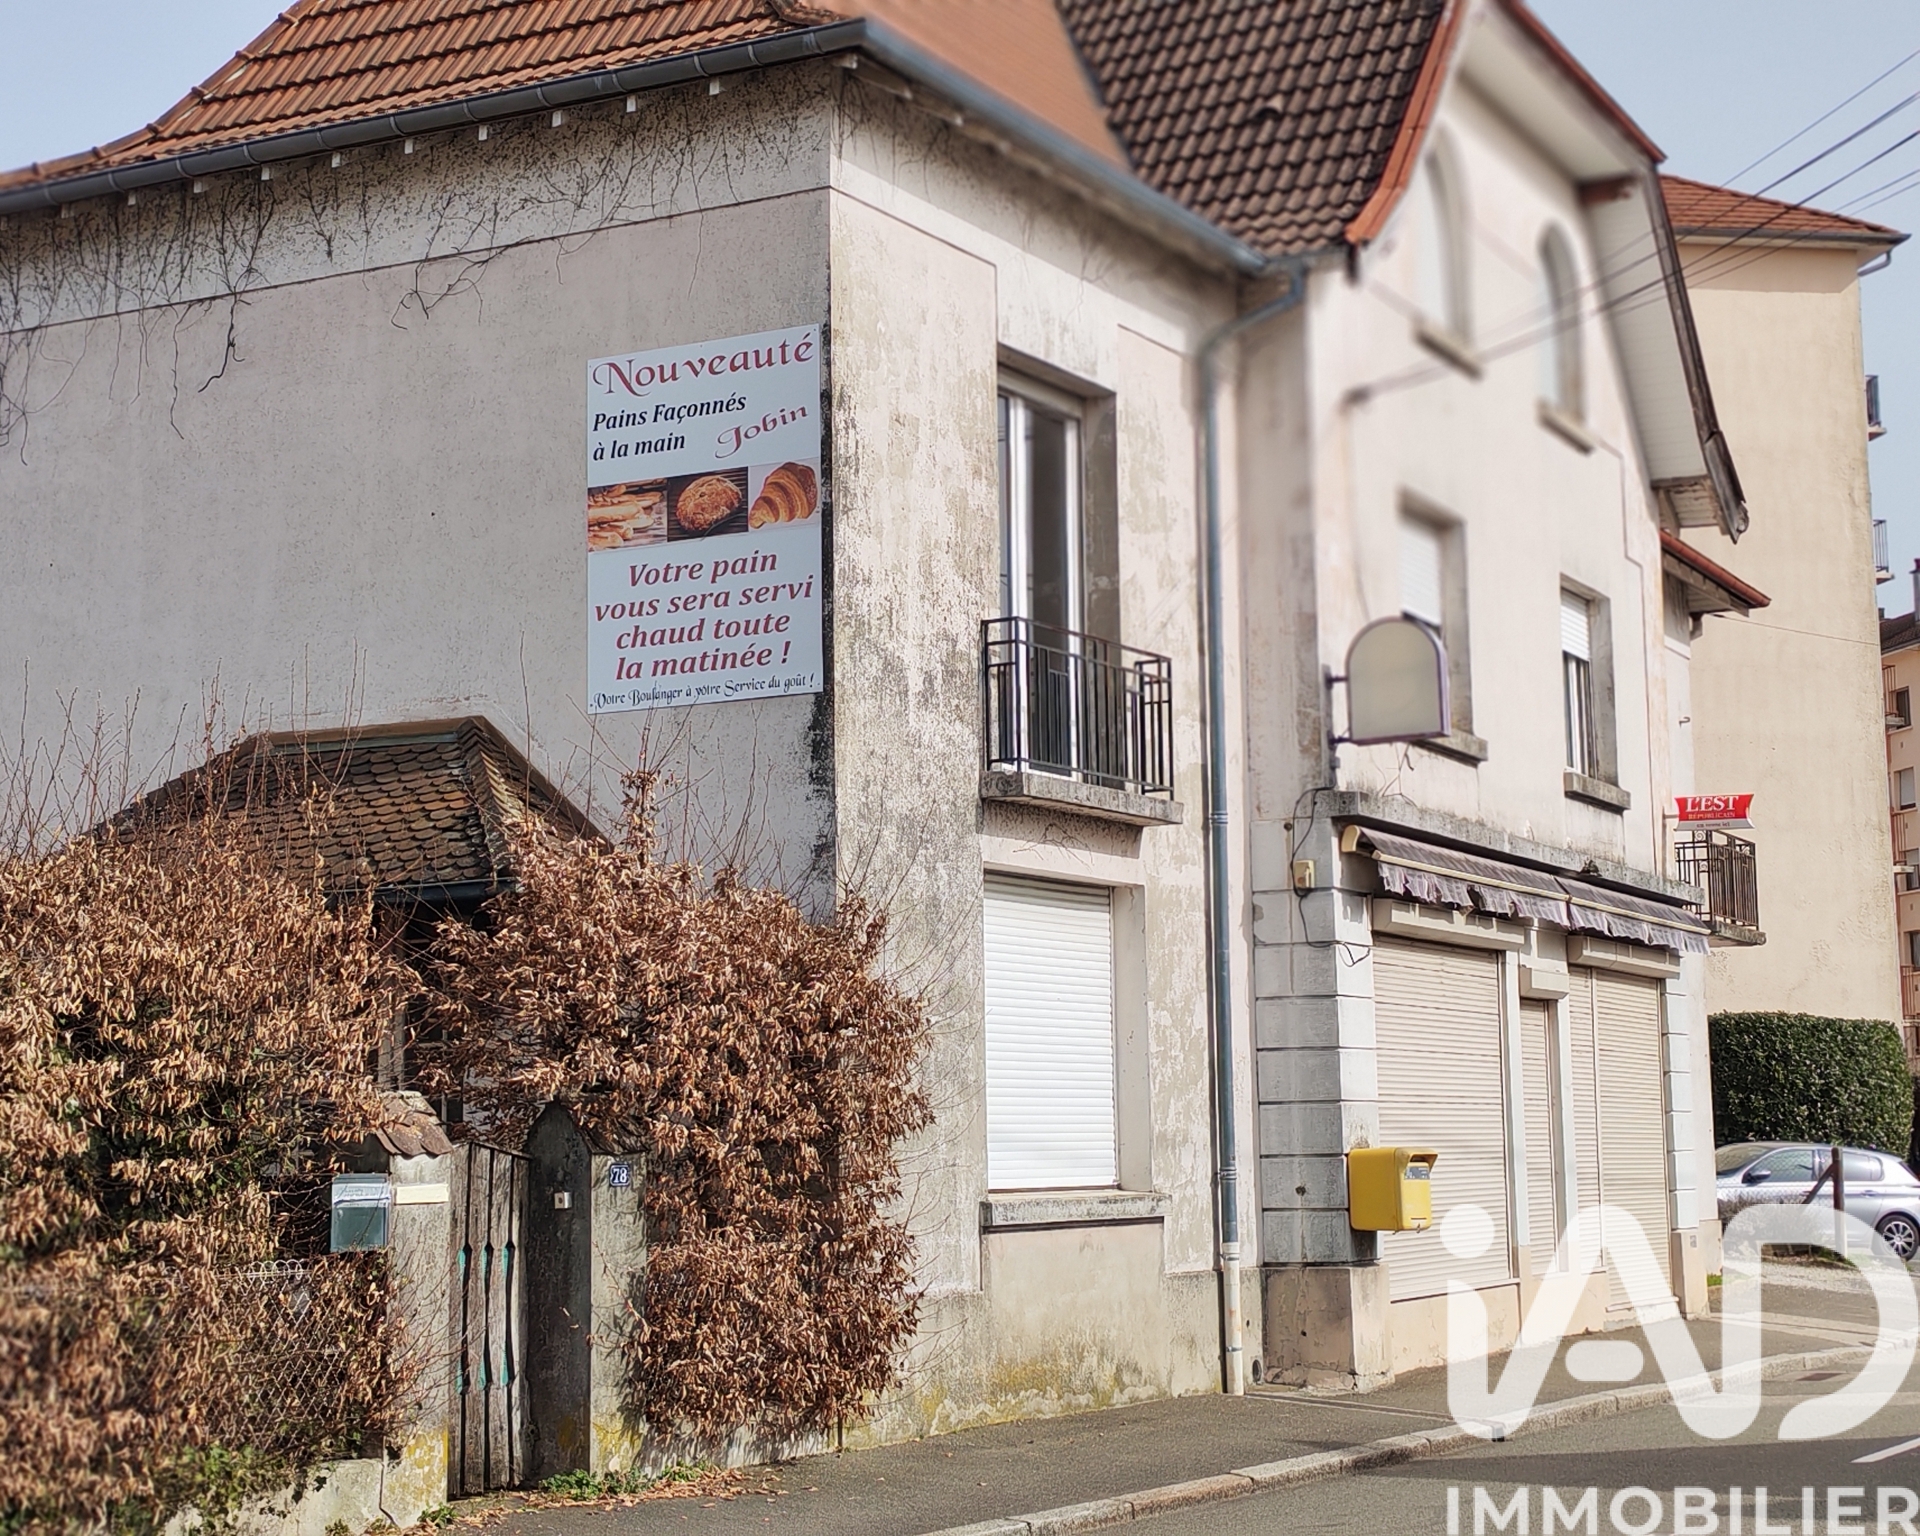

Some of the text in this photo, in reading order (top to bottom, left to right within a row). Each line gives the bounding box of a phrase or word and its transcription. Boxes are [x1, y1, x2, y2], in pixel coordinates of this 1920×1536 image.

[592, 332, 814, 397] Nouveauté
[592, 392, 747, 432] Pains Façonnés
[592, 433, 686, 461] à la main
[714, 406, 808, 459] Jobin
[629, 550, 778, 587] Votre pain
[595, 574, 814, 622] vous sera servi
[616, 613, 791, 650] chaud toute
[615, 657, 643, 681] la
[650, 642, 773, 677] matinée
[593, 692, 626, 709] Votre
[628, 685, 683, 706] Boulanger
[685, 685, 692, 697] à
[723, 678, 766, 697] Service
[768, 675, 781, 689] du
[783, 673, 806, 693] goût
[1685, 795, 1739, 813] L'EST
[613, 1167, 628, 1183] 78
